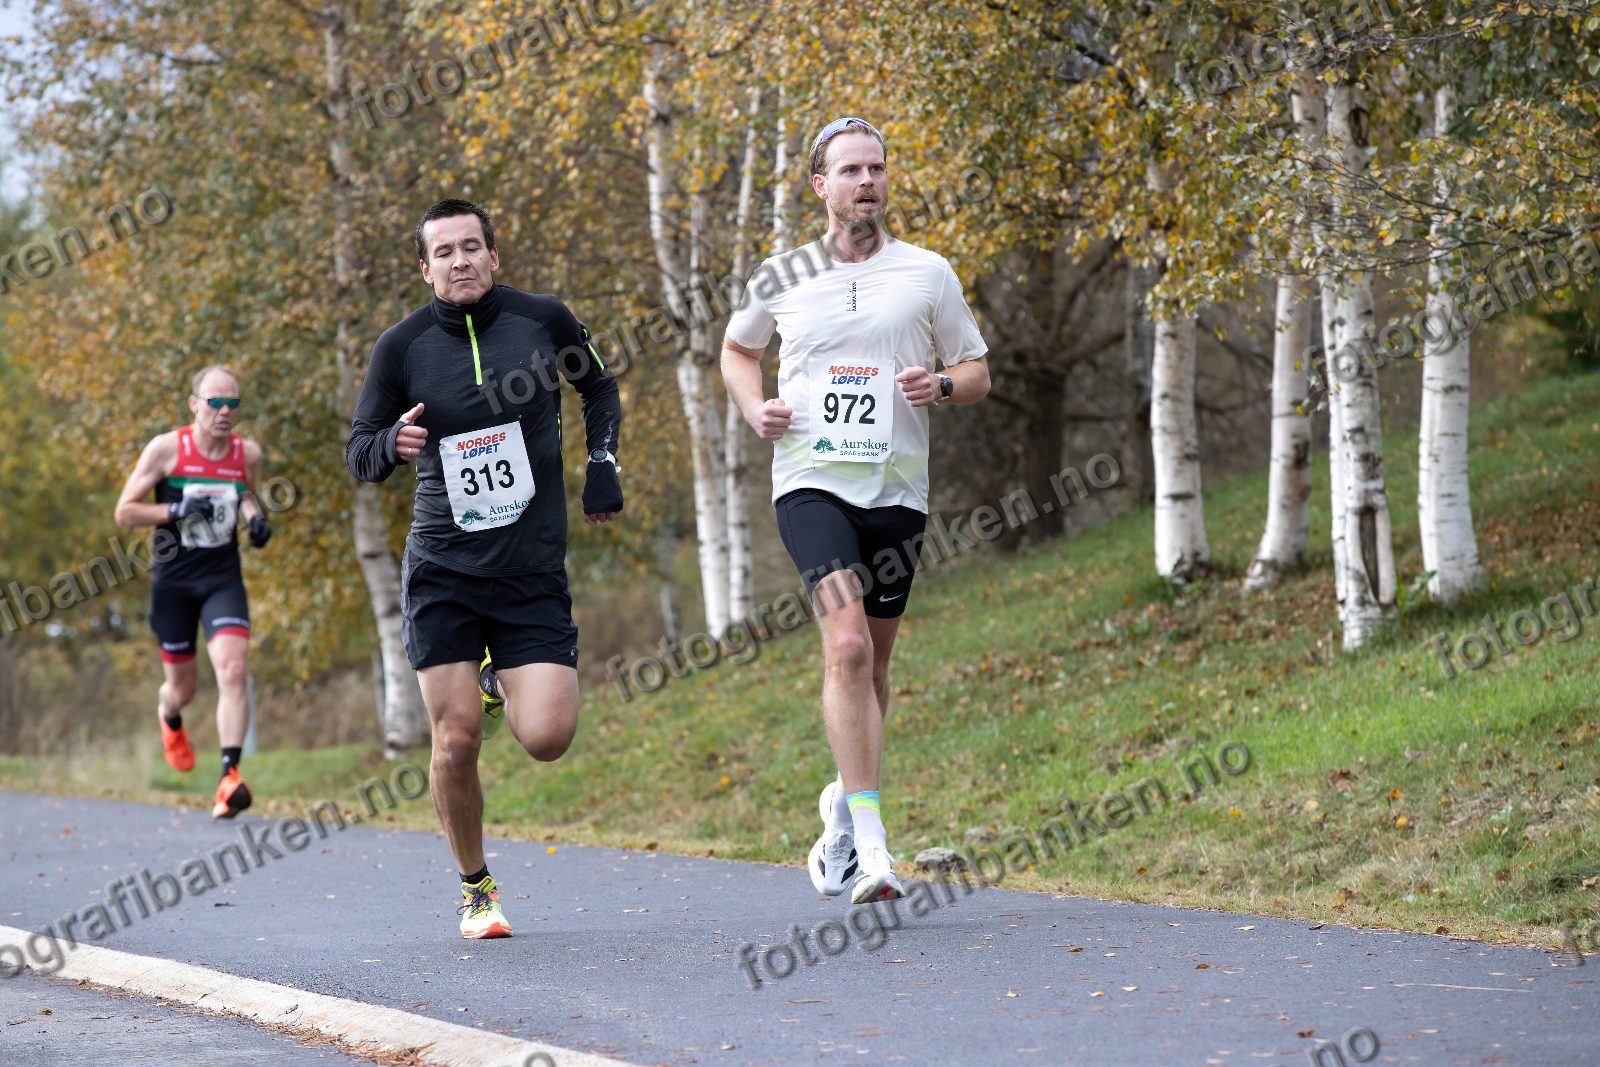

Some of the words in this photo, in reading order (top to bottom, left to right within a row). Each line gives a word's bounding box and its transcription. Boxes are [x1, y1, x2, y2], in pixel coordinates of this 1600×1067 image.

[829, 365, 879, 377] NORGES
[831, 375, 871, 386] LØPET
[823, 392, 876, 425] 972
[456, 431, 507, 451] NORGES
[840, 438, 889, 453] Aurskog
[463, 443, 500, 459] LØPET
[460, 459, 515, 496] 313
